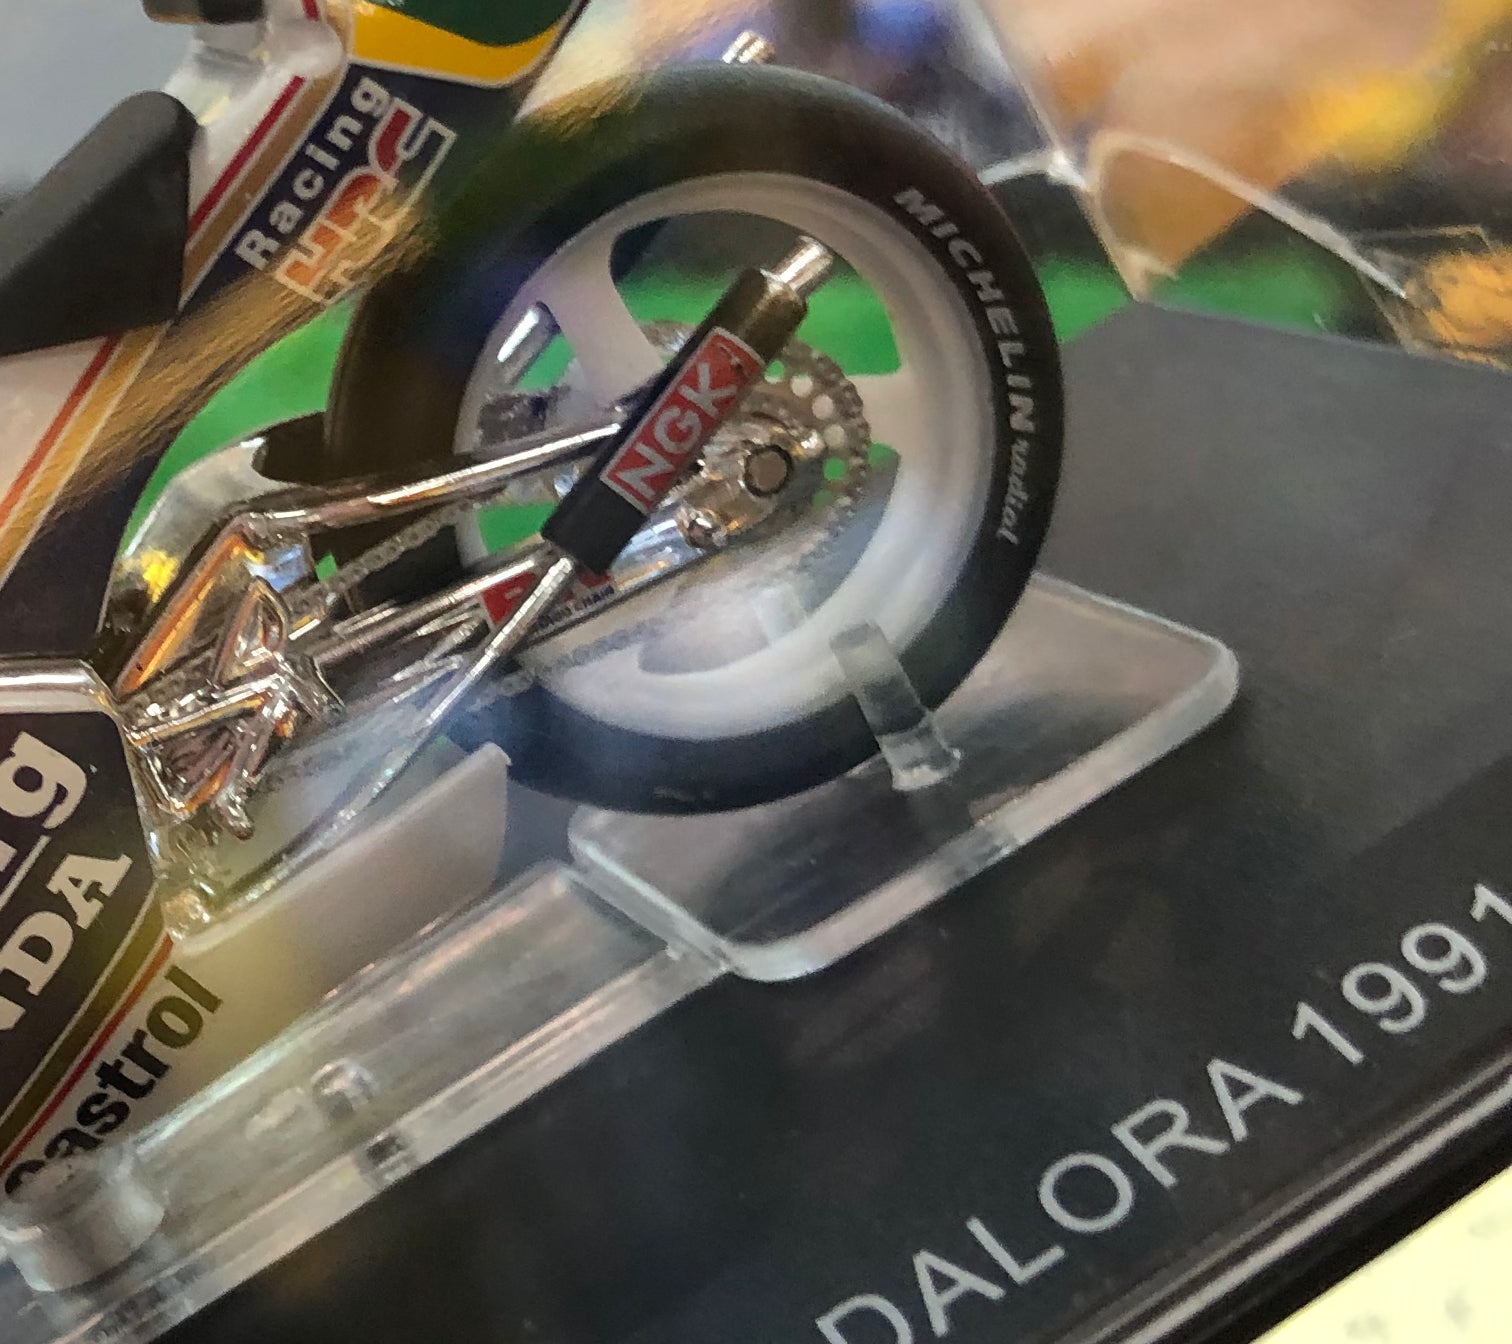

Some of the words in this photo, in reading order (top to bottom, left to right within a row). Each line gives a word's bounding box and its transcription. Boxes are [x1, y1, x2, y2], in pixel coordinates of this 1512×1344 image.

[234, 76, 392, 271] Racing
[893, 185, 1036, 434] MICHELIN
[615, 362, 738, 498] NGK
